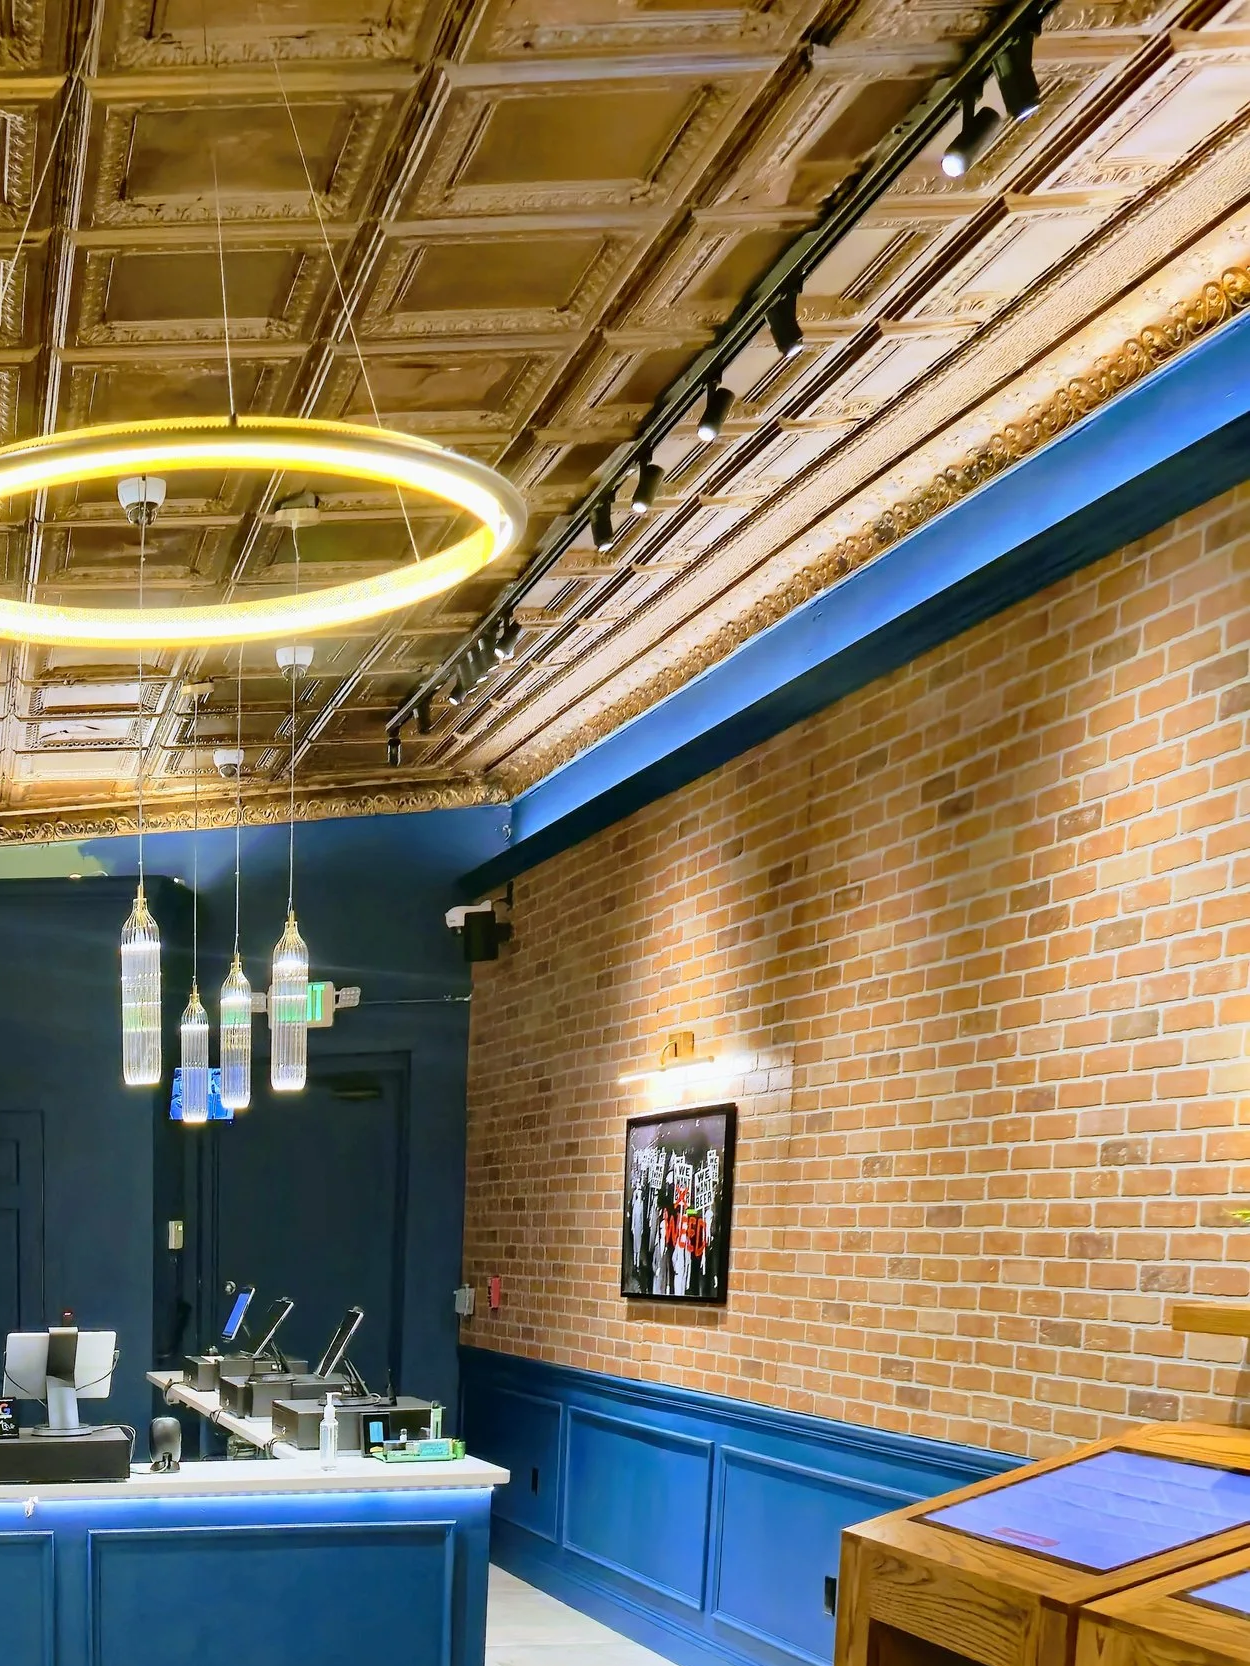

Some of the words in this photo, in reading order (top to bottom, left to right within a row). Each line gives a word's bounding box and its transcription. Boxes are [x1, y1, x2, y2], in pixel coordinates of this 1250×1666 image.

[679, 1165, 690, 1177] WE
[697, 1169, 710, 1182] WE
[695, 1191, 712, 1210] BEER
[663, 1208, 706, 1257] WEED
